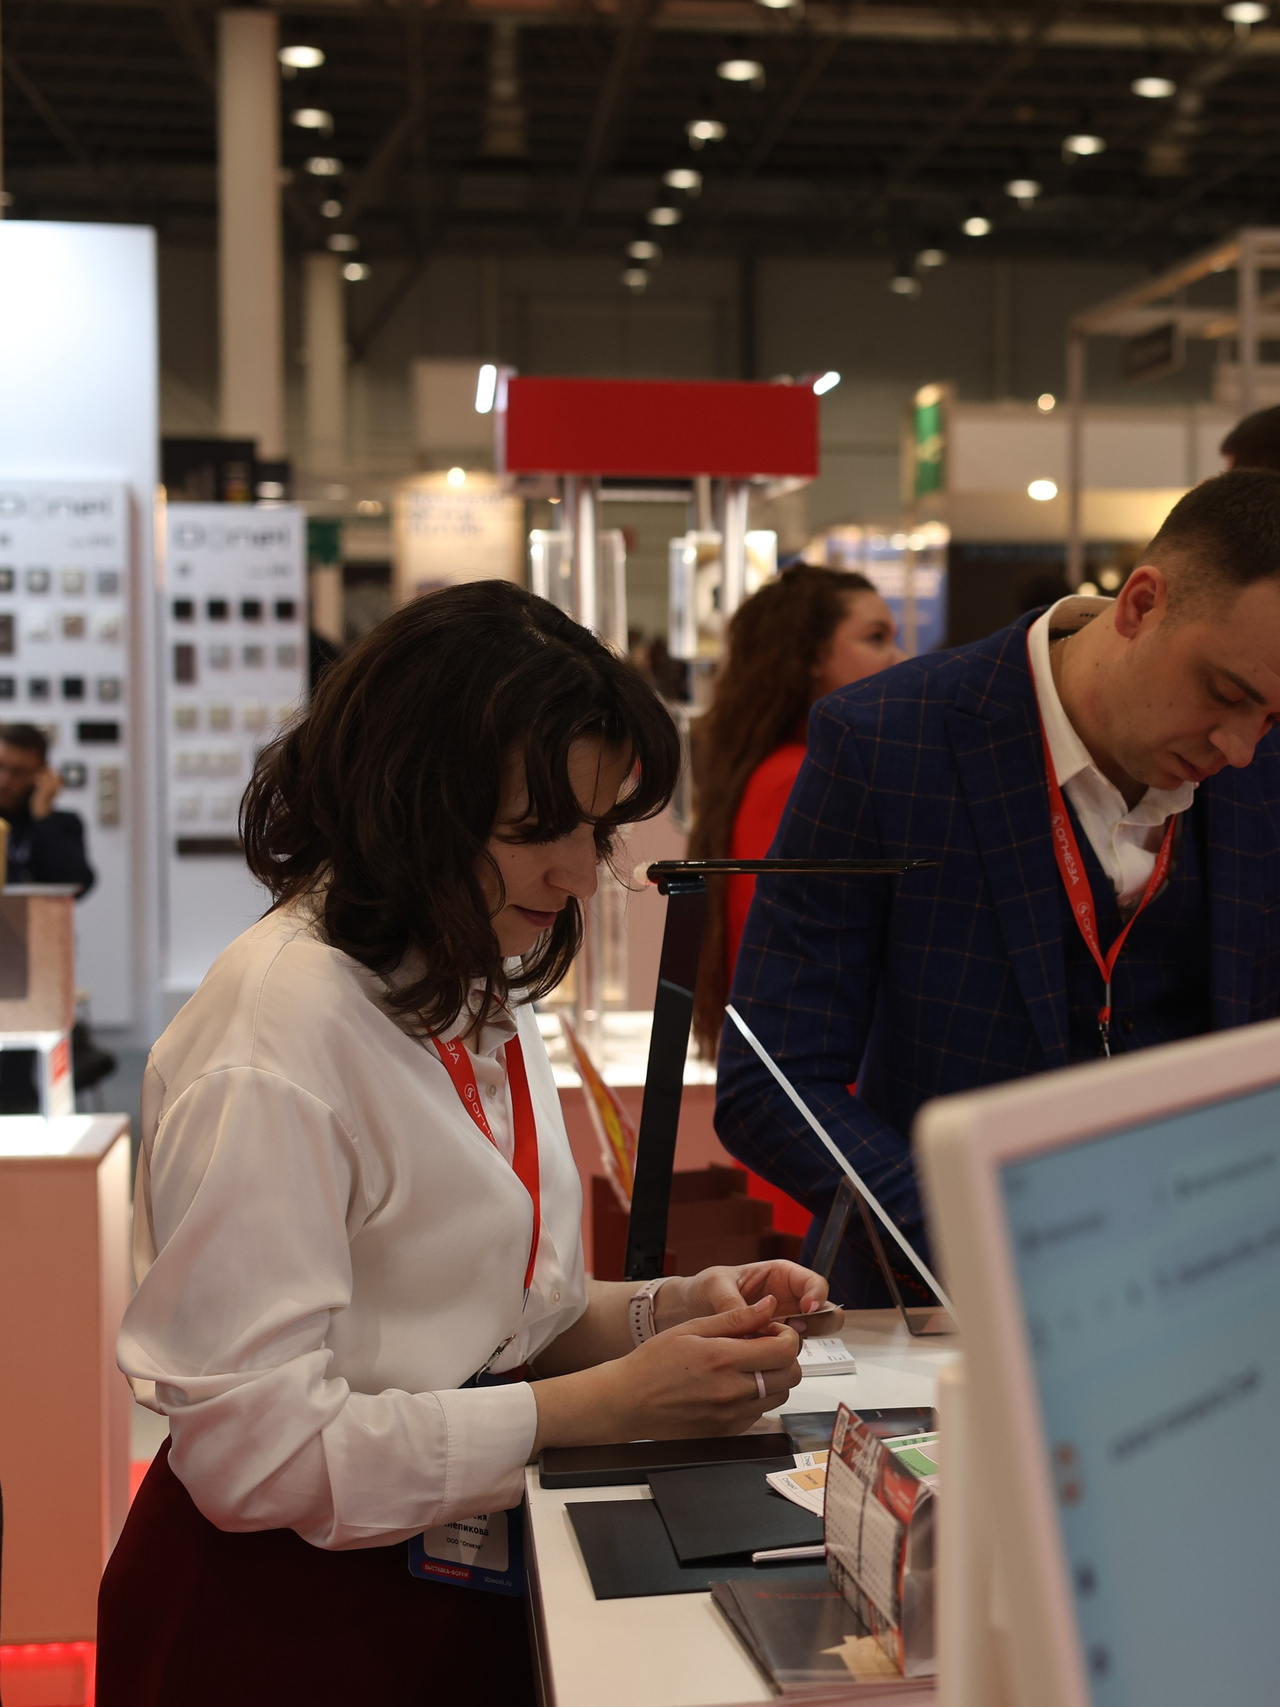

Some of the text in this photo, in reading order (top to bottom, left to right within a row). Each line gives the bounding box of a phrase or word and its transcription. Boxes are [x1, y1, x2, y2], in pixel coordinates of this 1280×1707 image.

[445, 1522, 489, 1536] лепикова
[446, 1537, 459, 1545] ООО
[424, 1564, 469, 1578] ВЫСТАВКА-ФОРУМ
